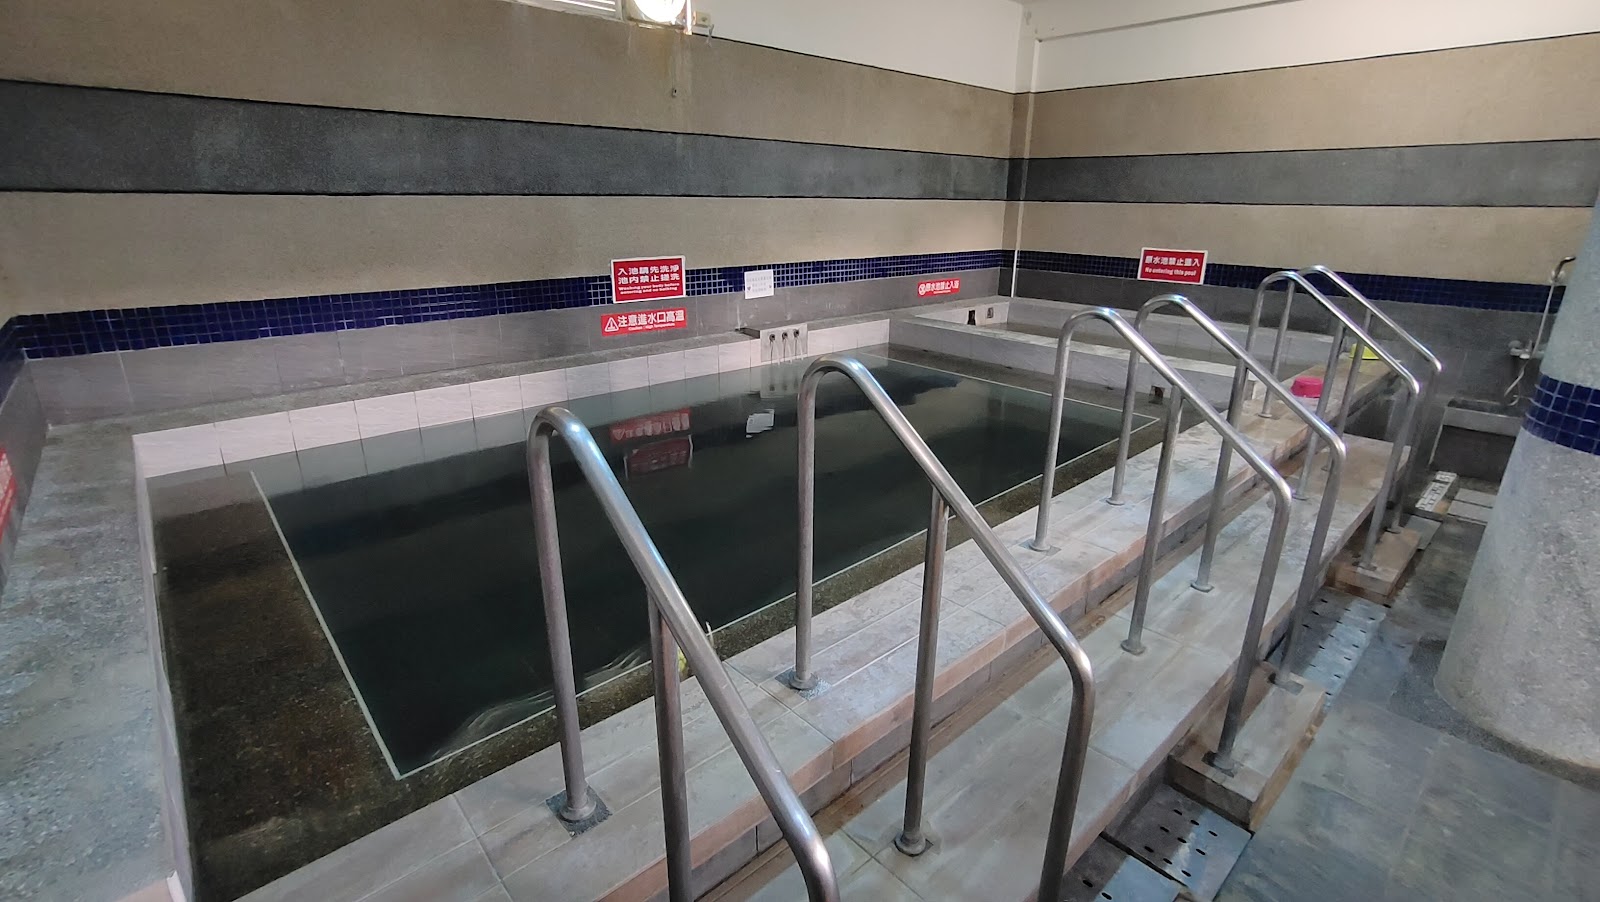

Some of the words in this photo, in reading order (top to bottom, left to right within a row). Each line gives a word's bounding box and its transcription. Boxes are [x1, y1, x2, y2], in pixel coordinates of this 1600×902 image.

[617, 309, 685, 328] 注意進水口高溫
